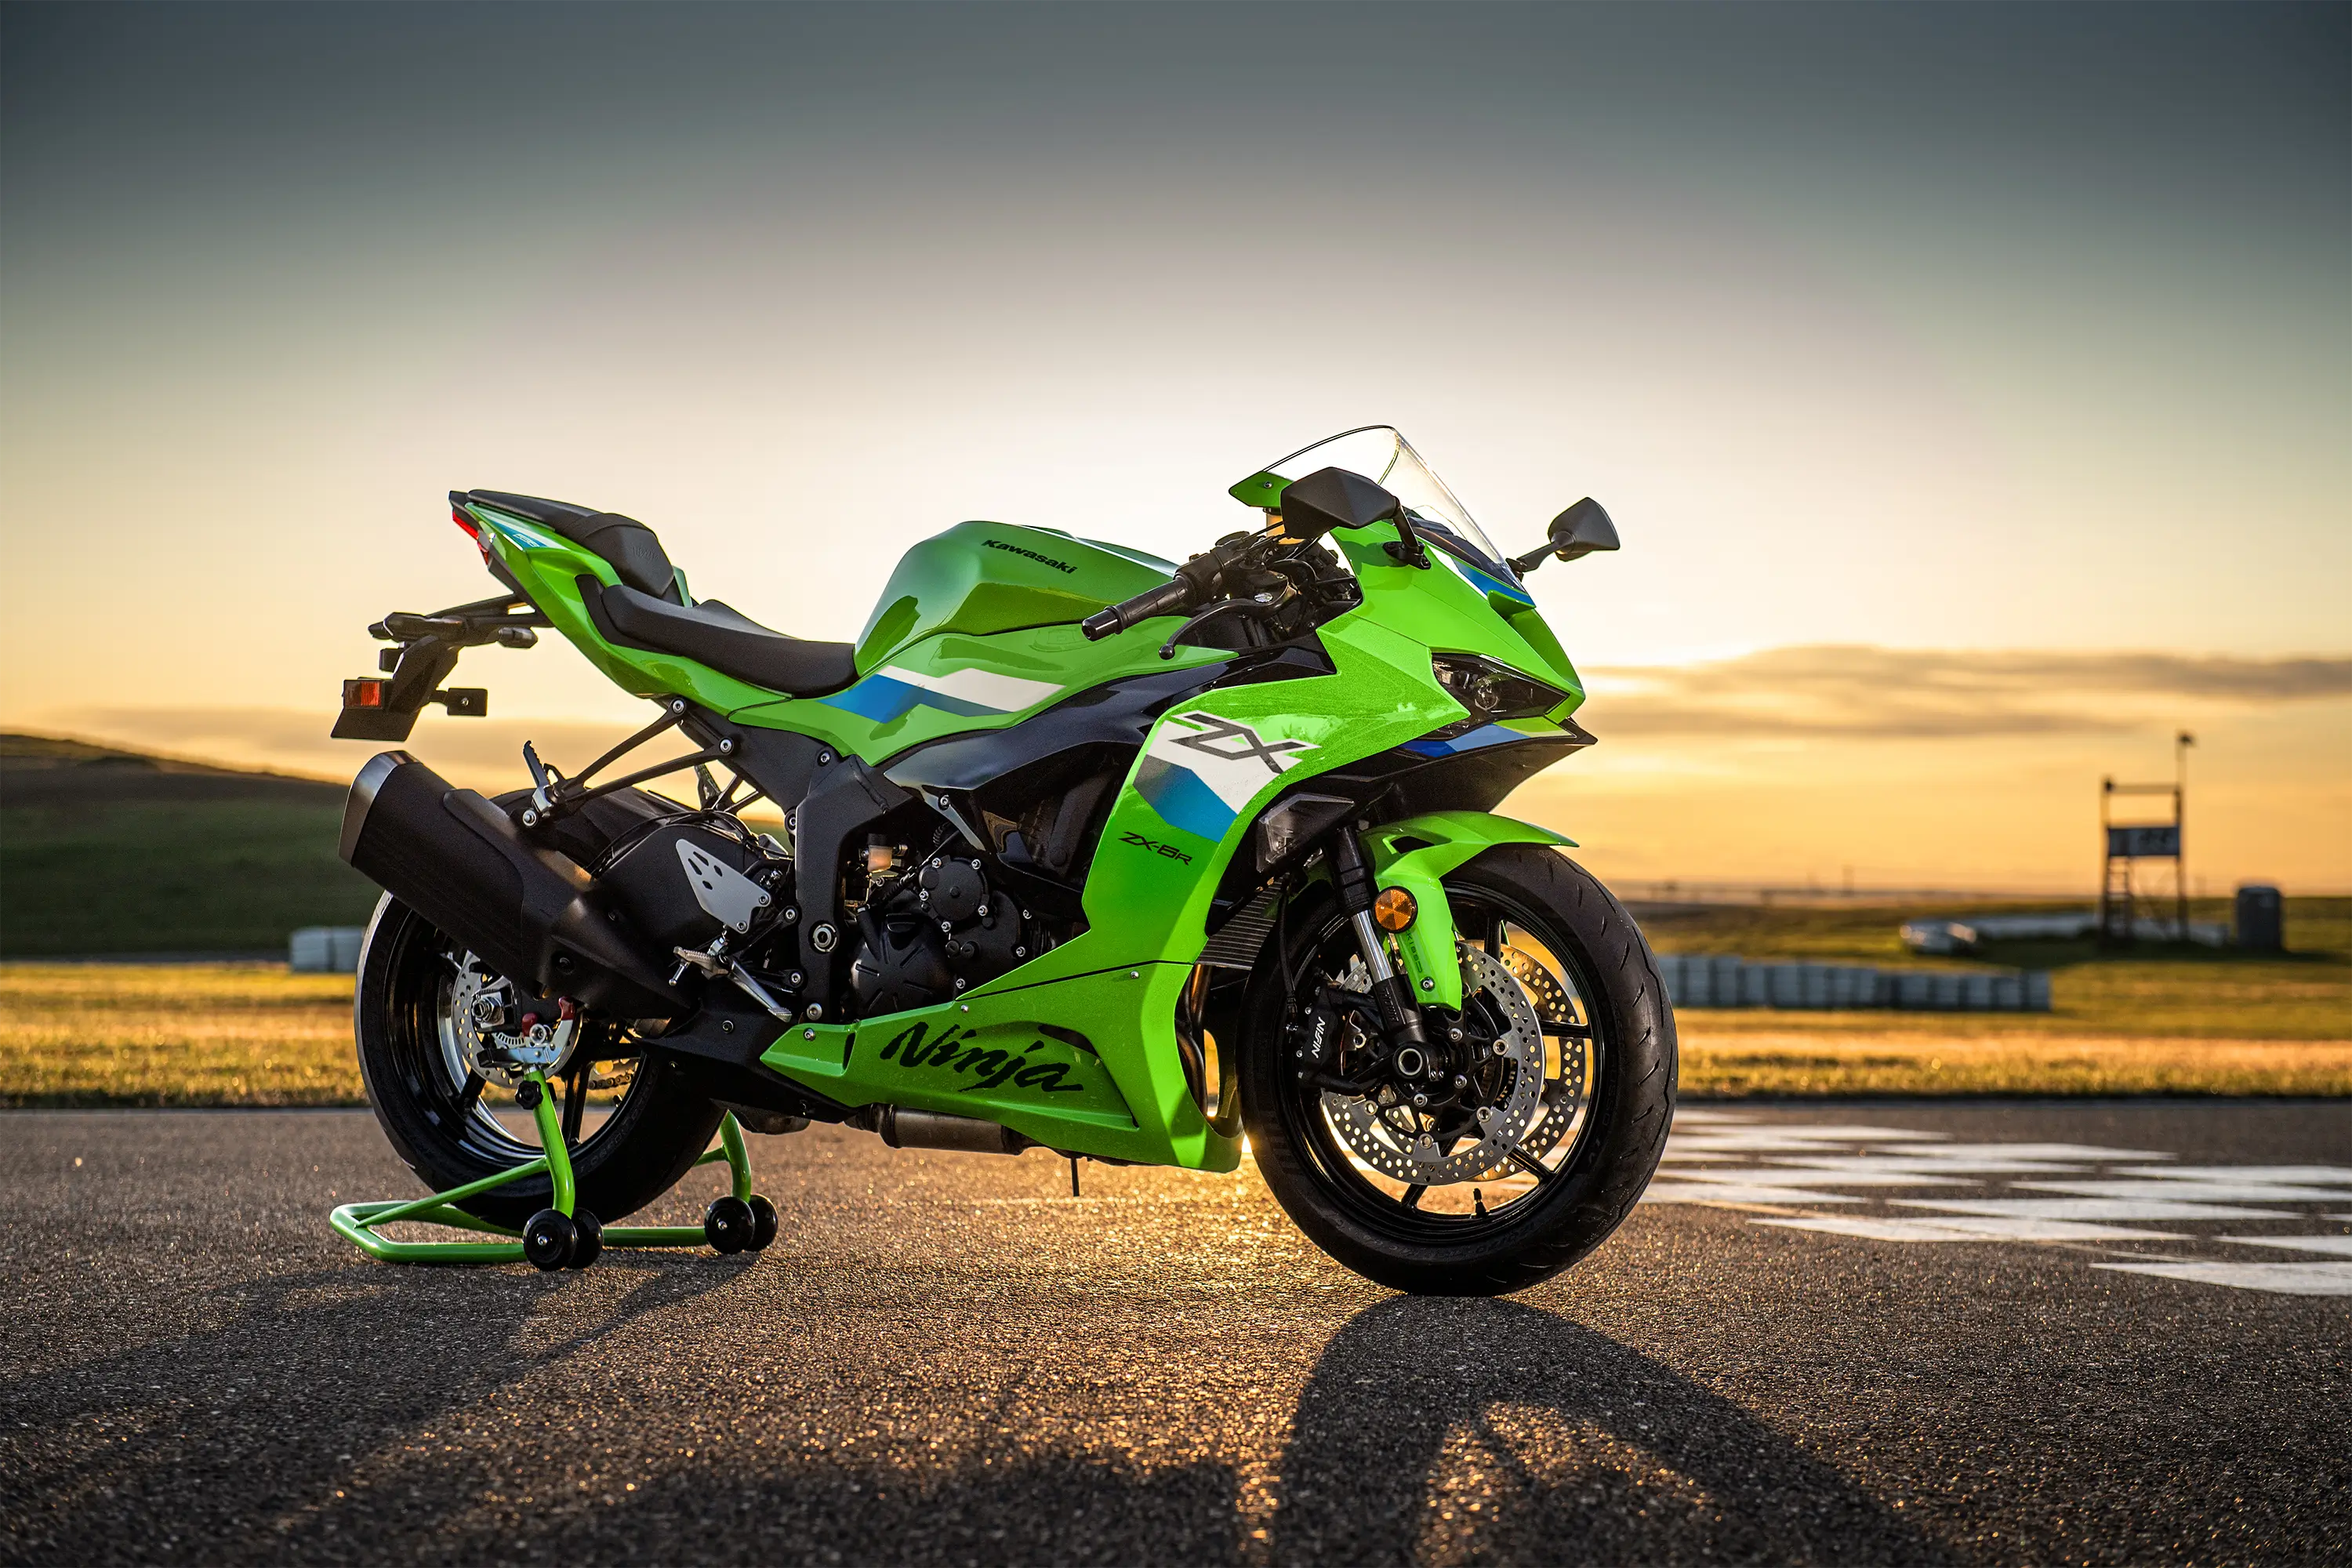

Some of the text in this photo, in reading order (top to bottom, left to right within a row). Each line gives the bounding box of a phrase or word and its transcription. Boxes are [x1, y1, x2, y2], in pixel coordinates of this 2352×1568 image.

[982, 539, 1077, 574] Kawasaki
[1118, 831, 1193, 866] ZX-6R
[880, 1021, 1083, 1092] Ninja
